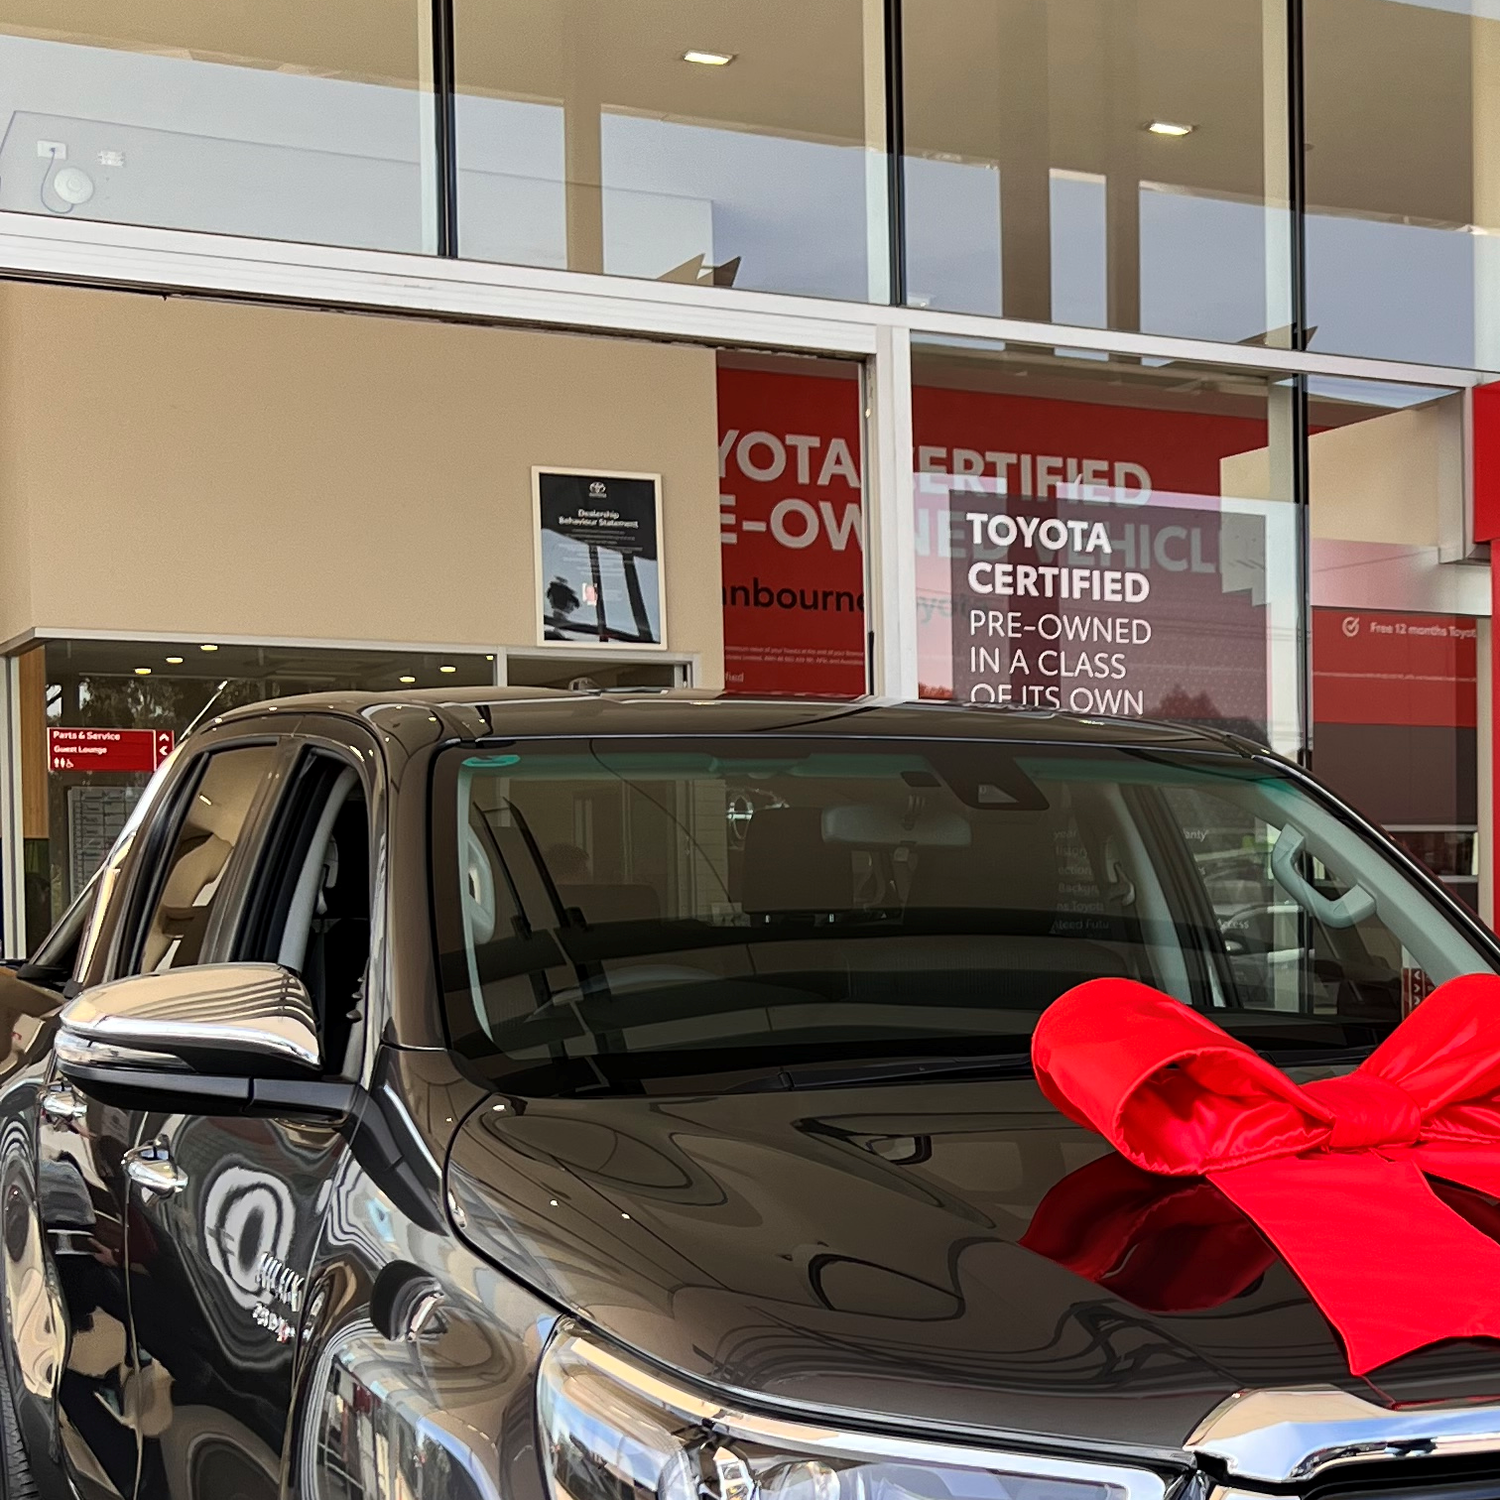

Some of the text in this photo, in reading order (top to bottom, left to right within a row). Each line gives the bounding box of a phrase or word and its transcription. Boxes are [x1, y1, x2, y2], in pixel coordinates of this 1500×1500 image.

[719, 429, 1152, 509] YOTA ERTIFIED
[966, 511, 1113, 554] TOYOTA
[967, 562, 1150, 604] CERTIFIED
[970, 609, 1152, 645] PRE-OWNED
[970, 646, 1127, 680] IN A CLASS
[970, 682, 1144, 716] OF ITS OWN
[53, 731, 121, 741] Parts & Service
[53, 744, 108, 756] Guest Lounge
